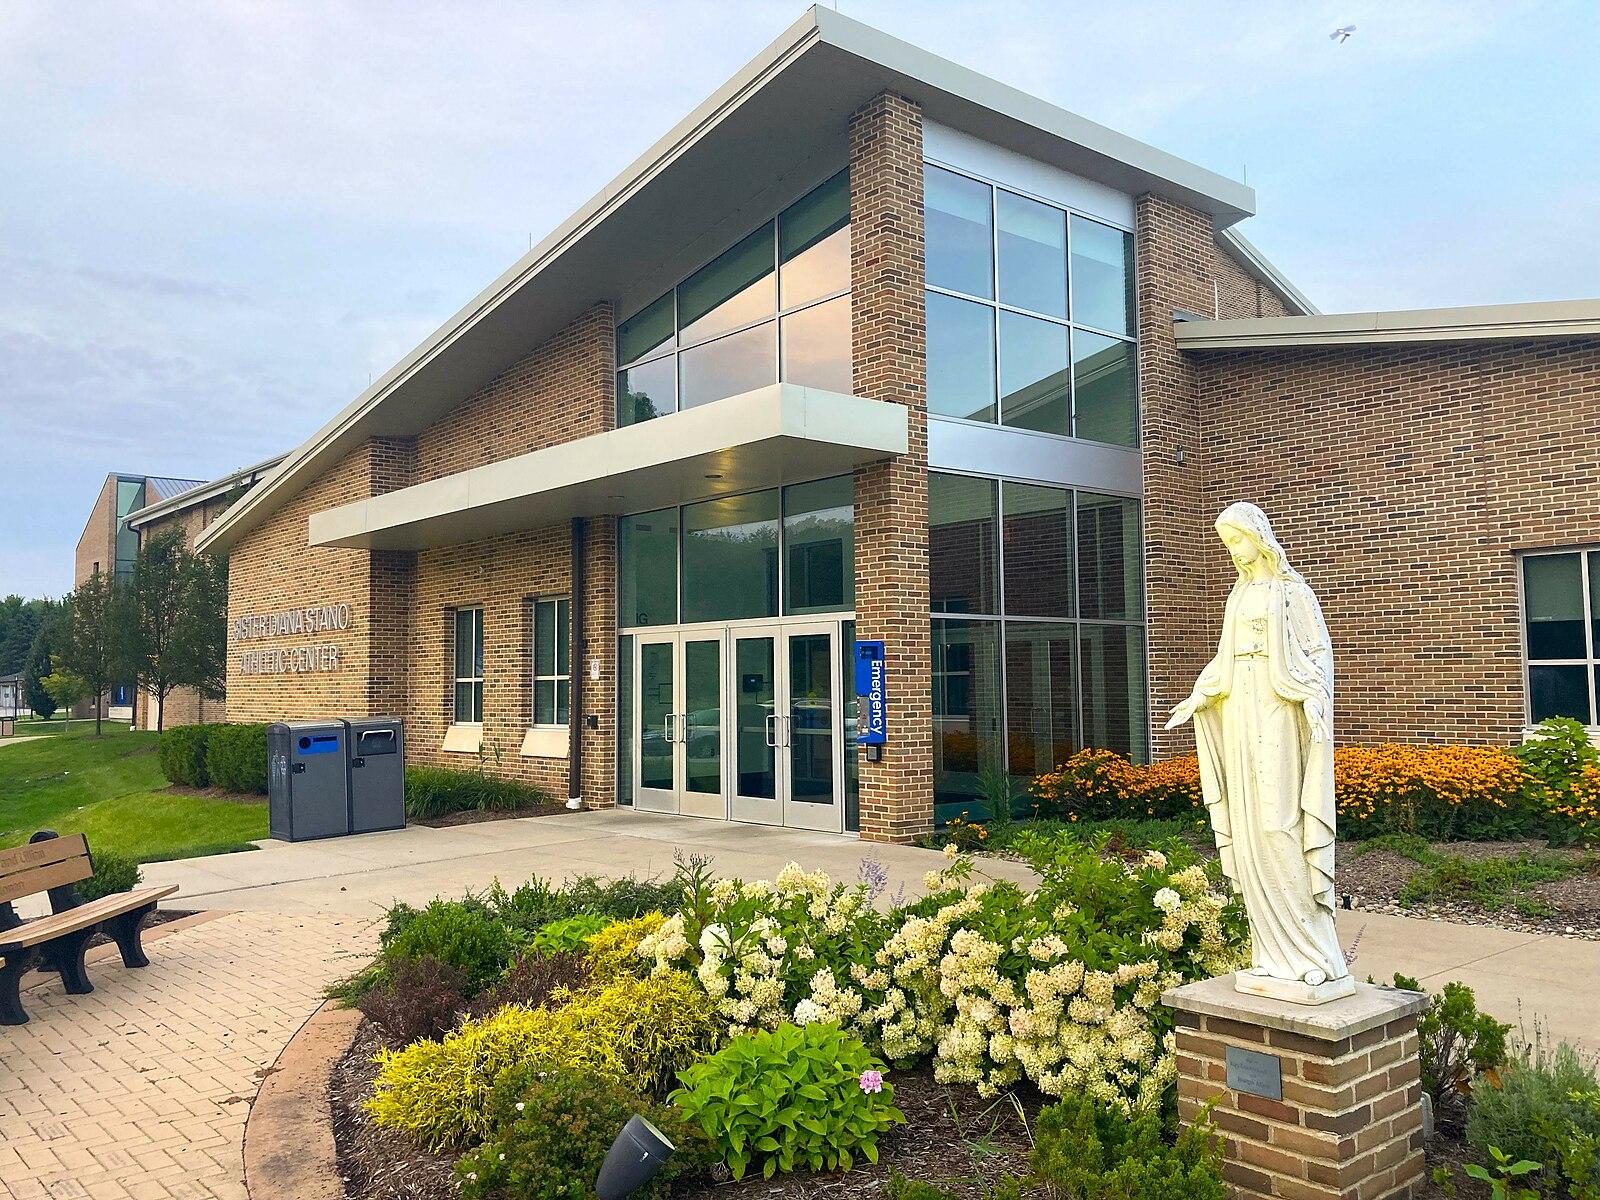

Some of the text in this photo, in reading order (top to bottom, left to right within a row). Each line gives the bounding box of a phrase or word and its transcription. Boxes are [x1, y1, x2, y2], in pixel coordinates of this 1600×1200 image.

[233, 603, 349, 640] SISTER DIANA STANO
[240, 645, 339, 675] ATHLETIC CENTER
[869, 660, 883, 735] Emergency
